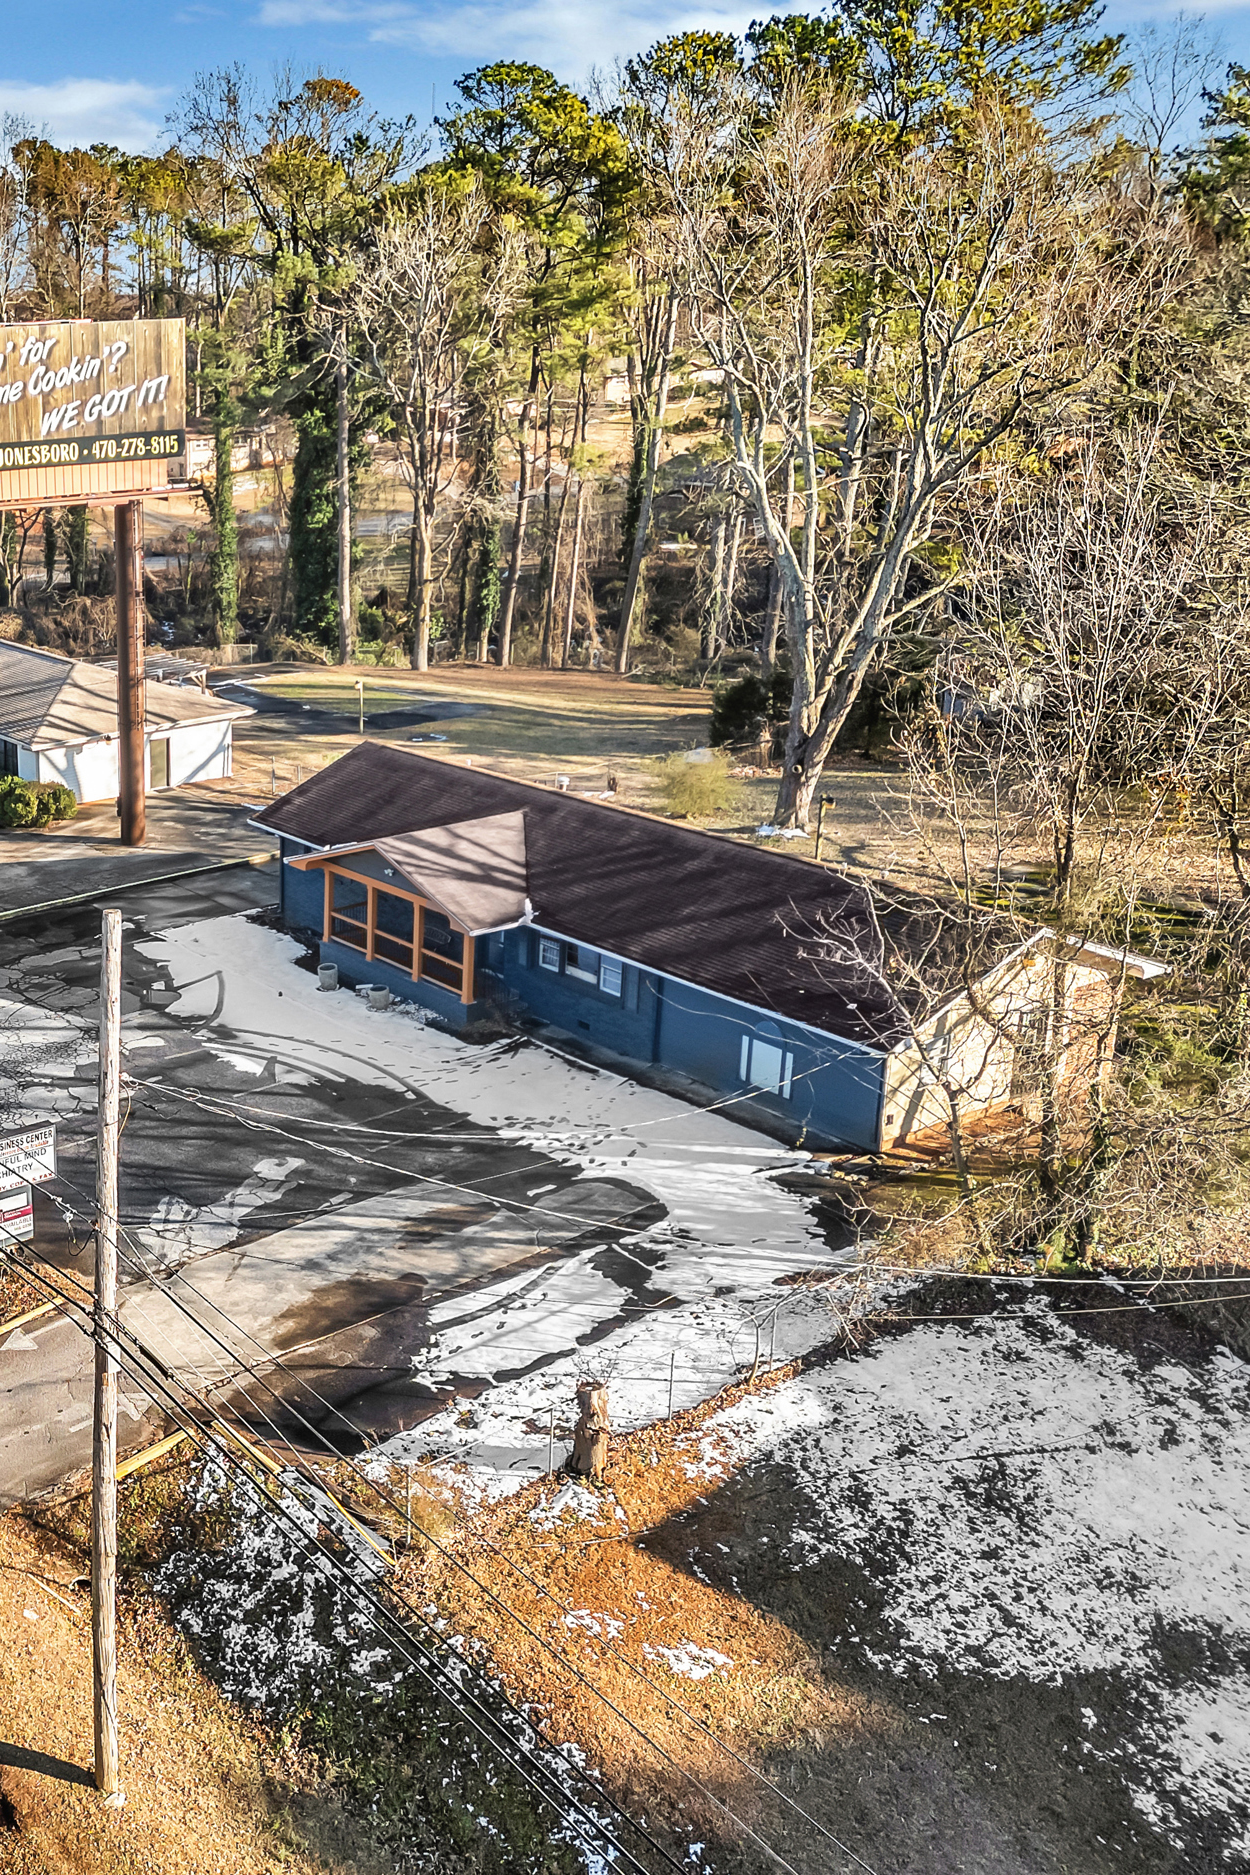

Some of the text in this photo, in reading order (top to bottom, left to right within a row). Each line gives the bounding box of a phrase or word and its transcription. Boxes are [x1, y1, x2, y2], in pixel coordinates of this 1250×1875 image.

[19, 336, 56, 366] for
[28, 341, 127, 395] Cookin'?
[41, 374, 169, 436] WE GOT IT!
[91, 435, 179, 459] 470-278-8115
[26, 1130, 53, 1144] CENTER
[24, 1147, 47, 1161] MIND
